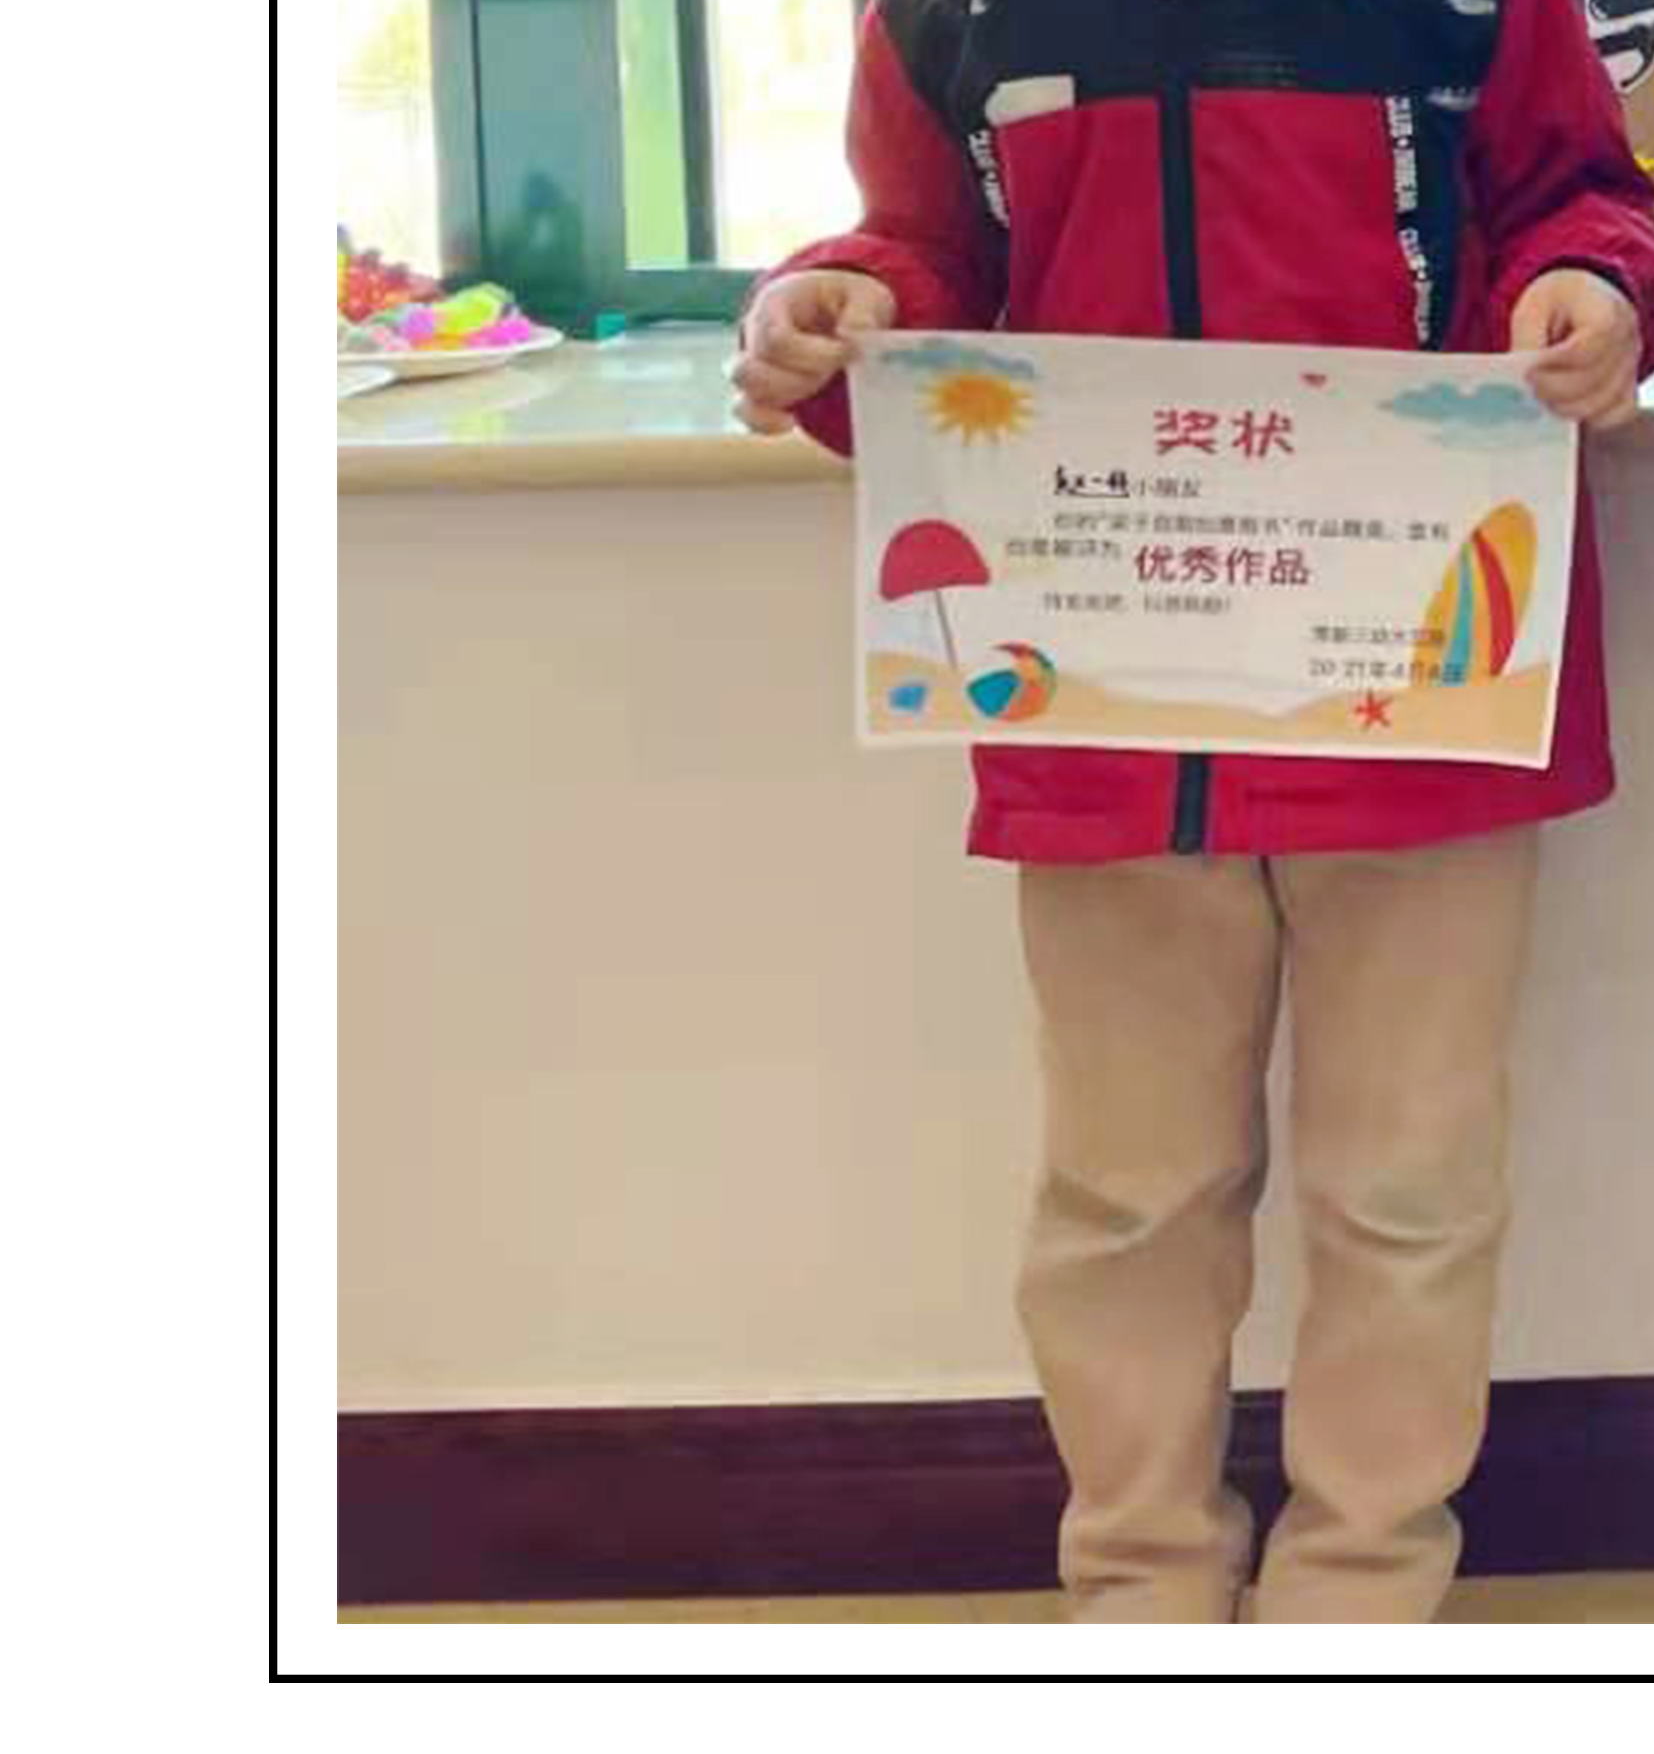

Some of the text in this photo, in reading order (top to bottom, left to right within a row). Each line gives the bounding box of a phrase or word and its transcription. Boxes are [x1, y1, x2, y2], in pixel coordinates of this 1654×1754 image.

[1152, 408, 1298, 459] 奖状
[1134, 544, 1310, 587] 优秀作品
